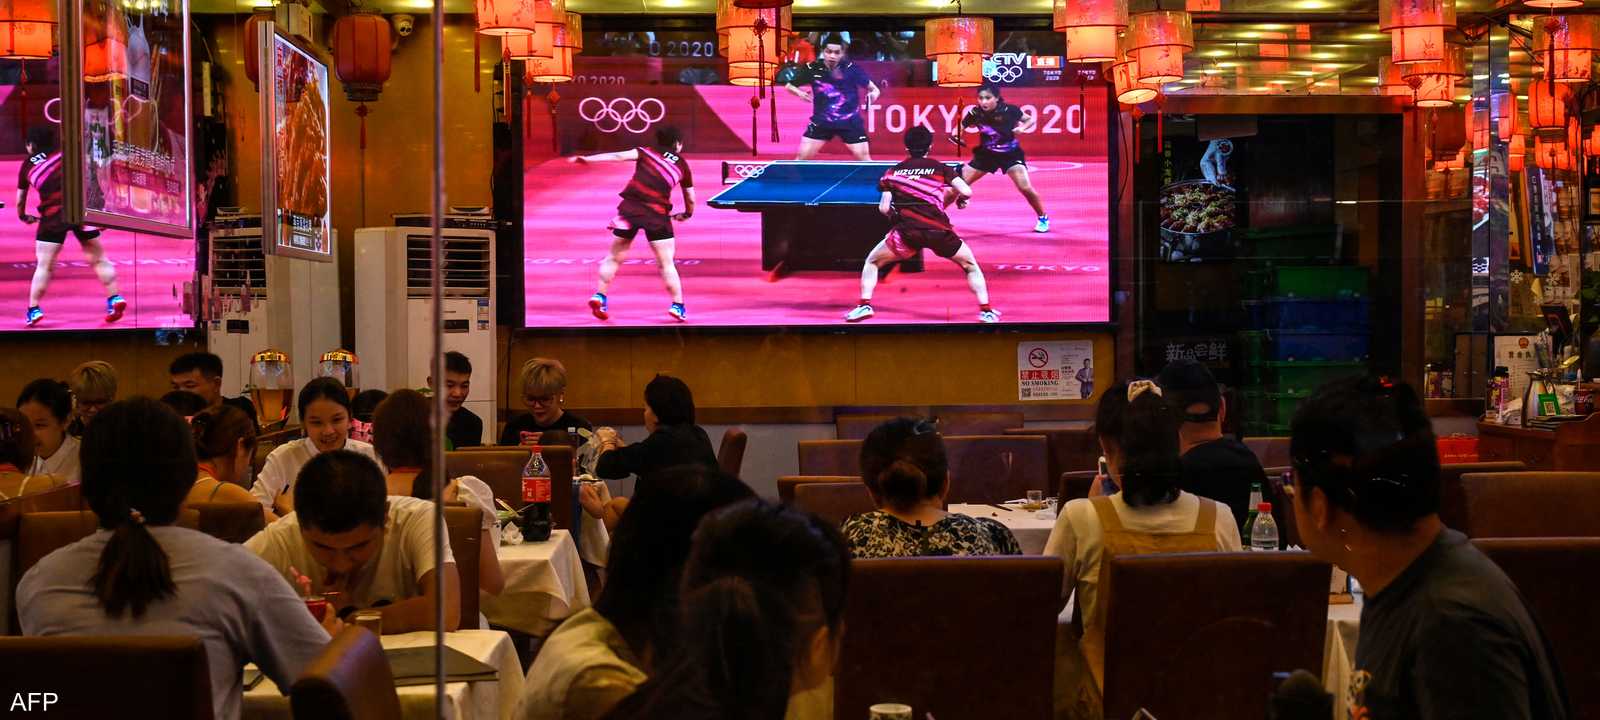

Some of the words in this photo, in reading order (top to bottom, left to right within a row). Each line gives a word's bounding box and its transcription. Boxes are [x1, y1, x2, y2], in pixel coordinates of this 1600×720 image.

[667, 41, 714, 57] 2020
[590, 76, 625, 86] 2020
[1020, 104, 1086, 134] 020
[663, 151, 680, 161] ITO
[893, 168, 935, 177] MIZUTANI
[623, 257, 702, 265] 200
[993, 264, 1100, 272] TOKYO
